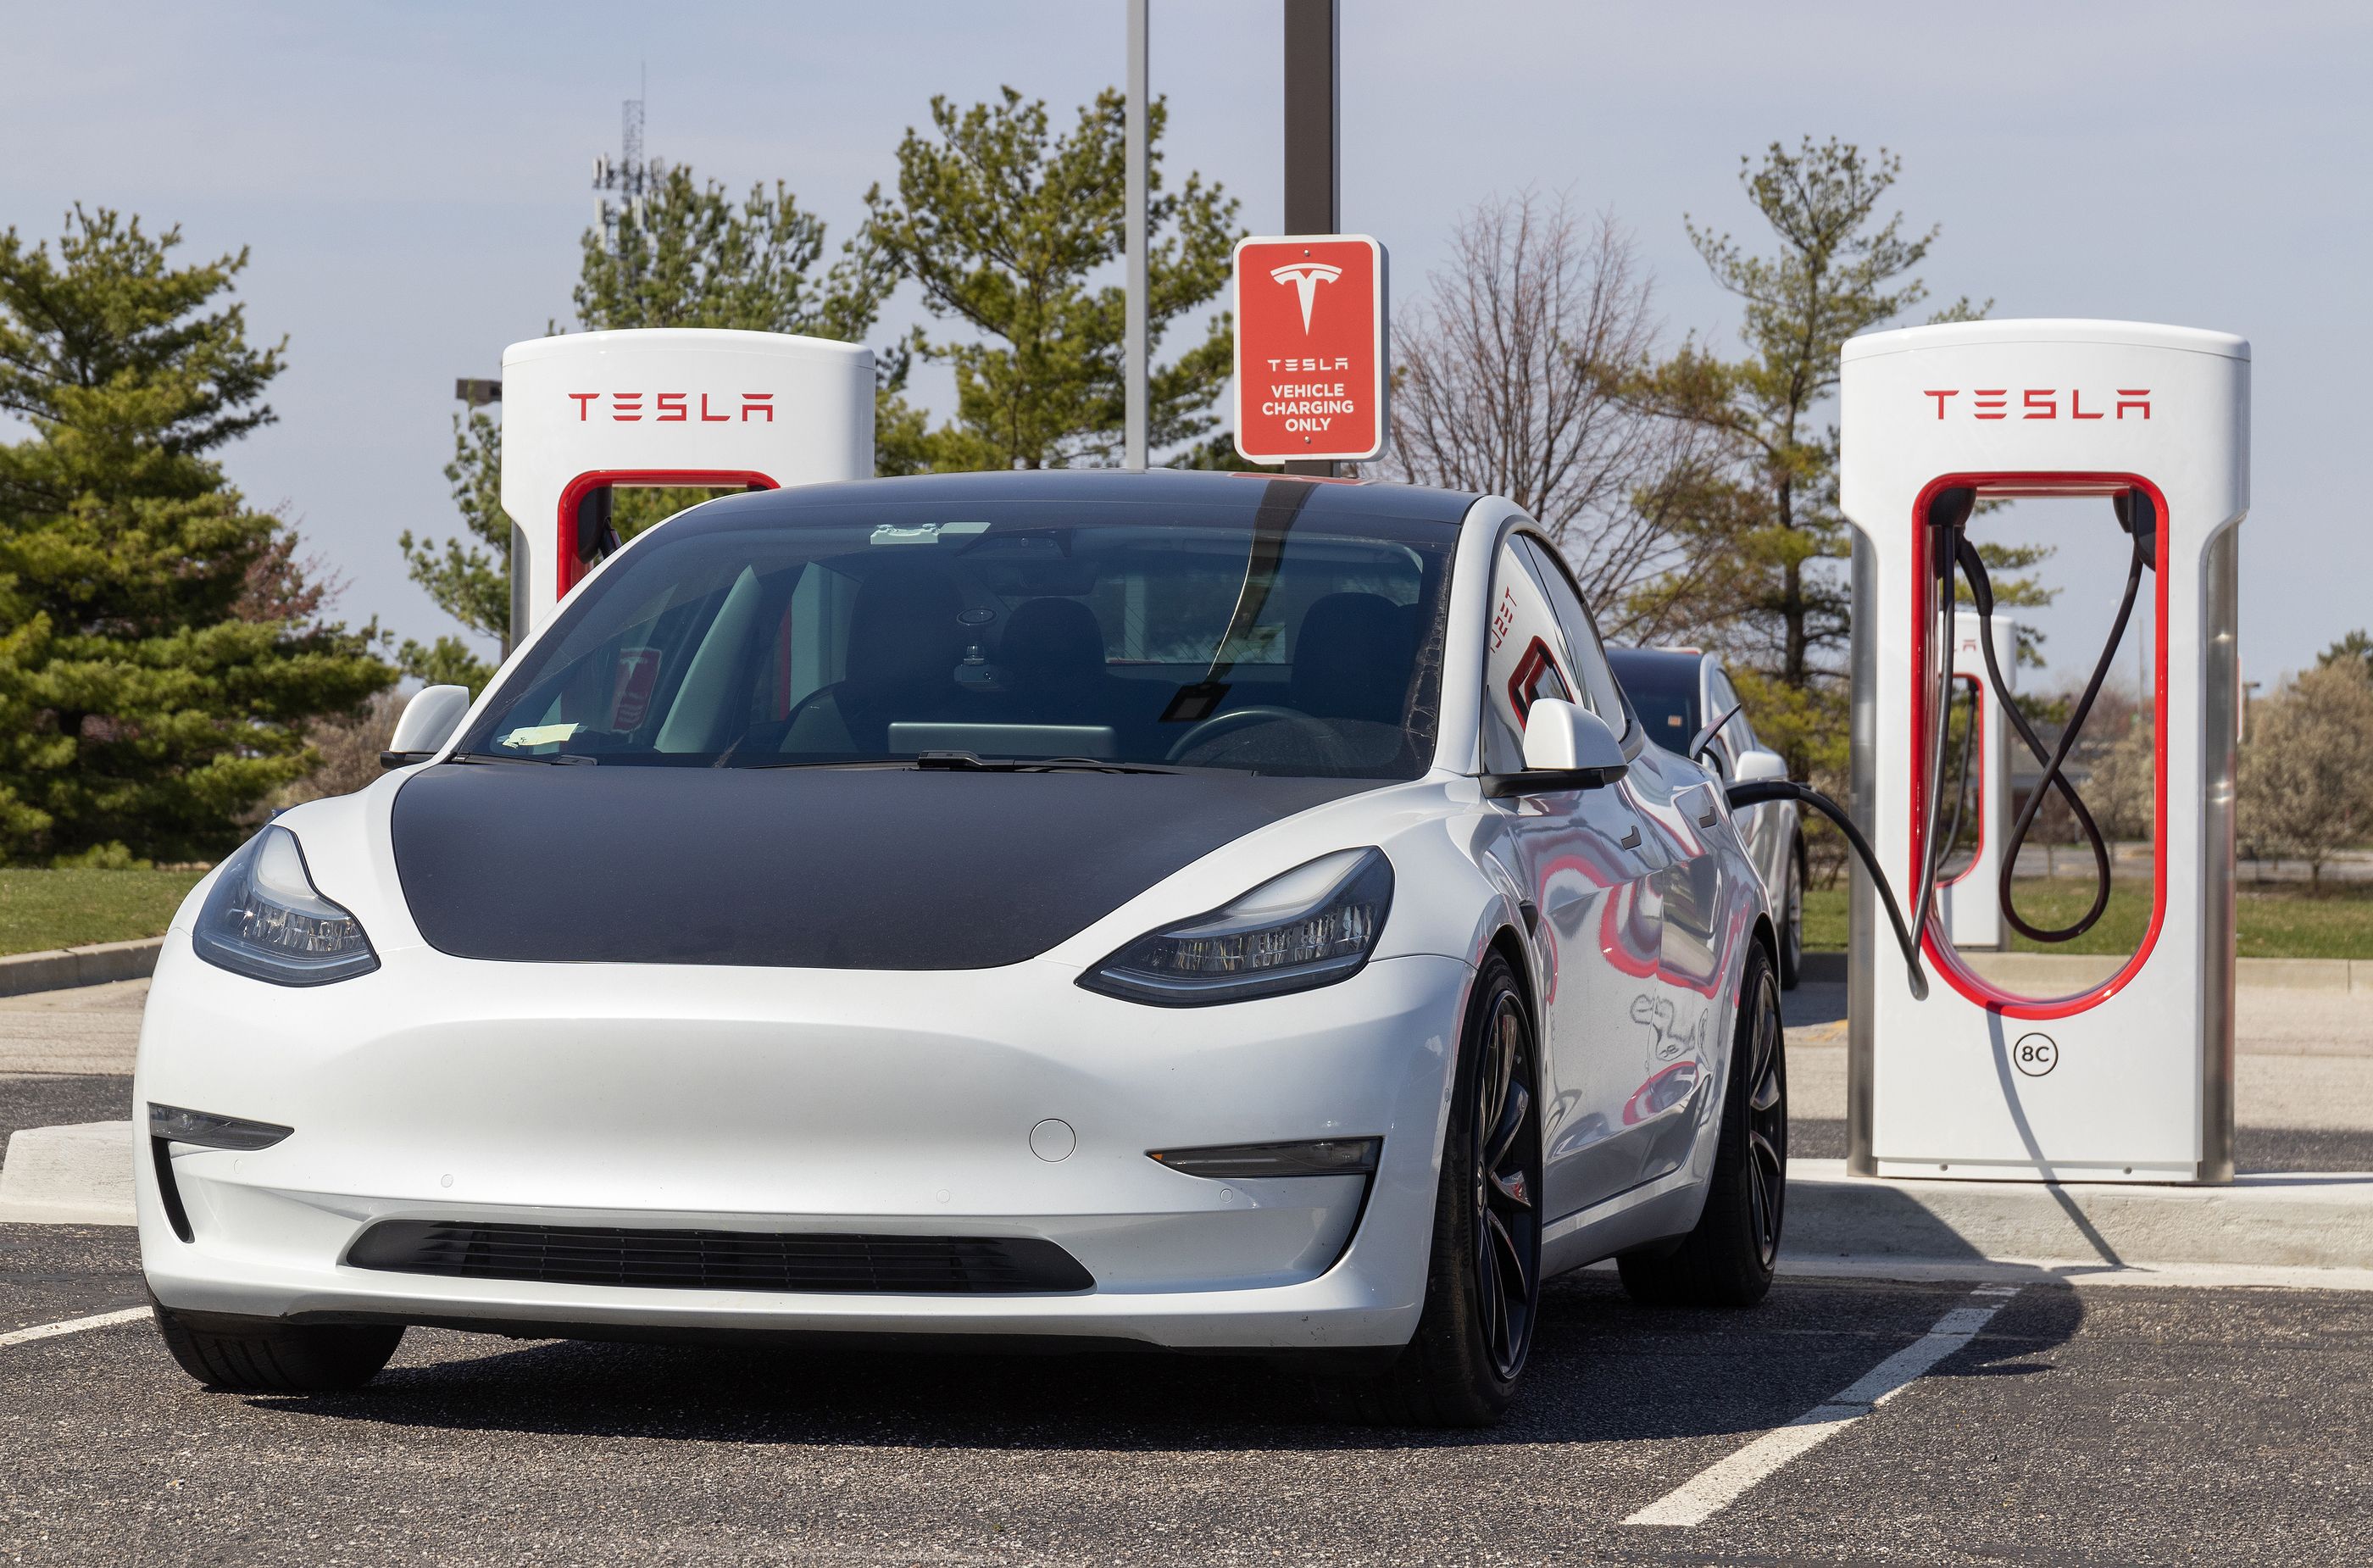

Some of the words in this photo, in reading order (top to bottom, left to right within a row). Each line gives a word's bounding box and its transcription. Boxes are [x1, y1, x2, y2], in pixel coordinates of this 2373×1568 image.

[1267, 357, 1348, 372] TESLA
[1271, 383, 1344, 398] VEHICLE
[567, 392, 774, 422] TESLA
[1261, 400, 1354, 415] CHARGING
[1922, 388, 2151, 420] TESLA
[1285, 418, 1331, 431] ONLY
[2021, 1045, 2049, 1062] 8C
